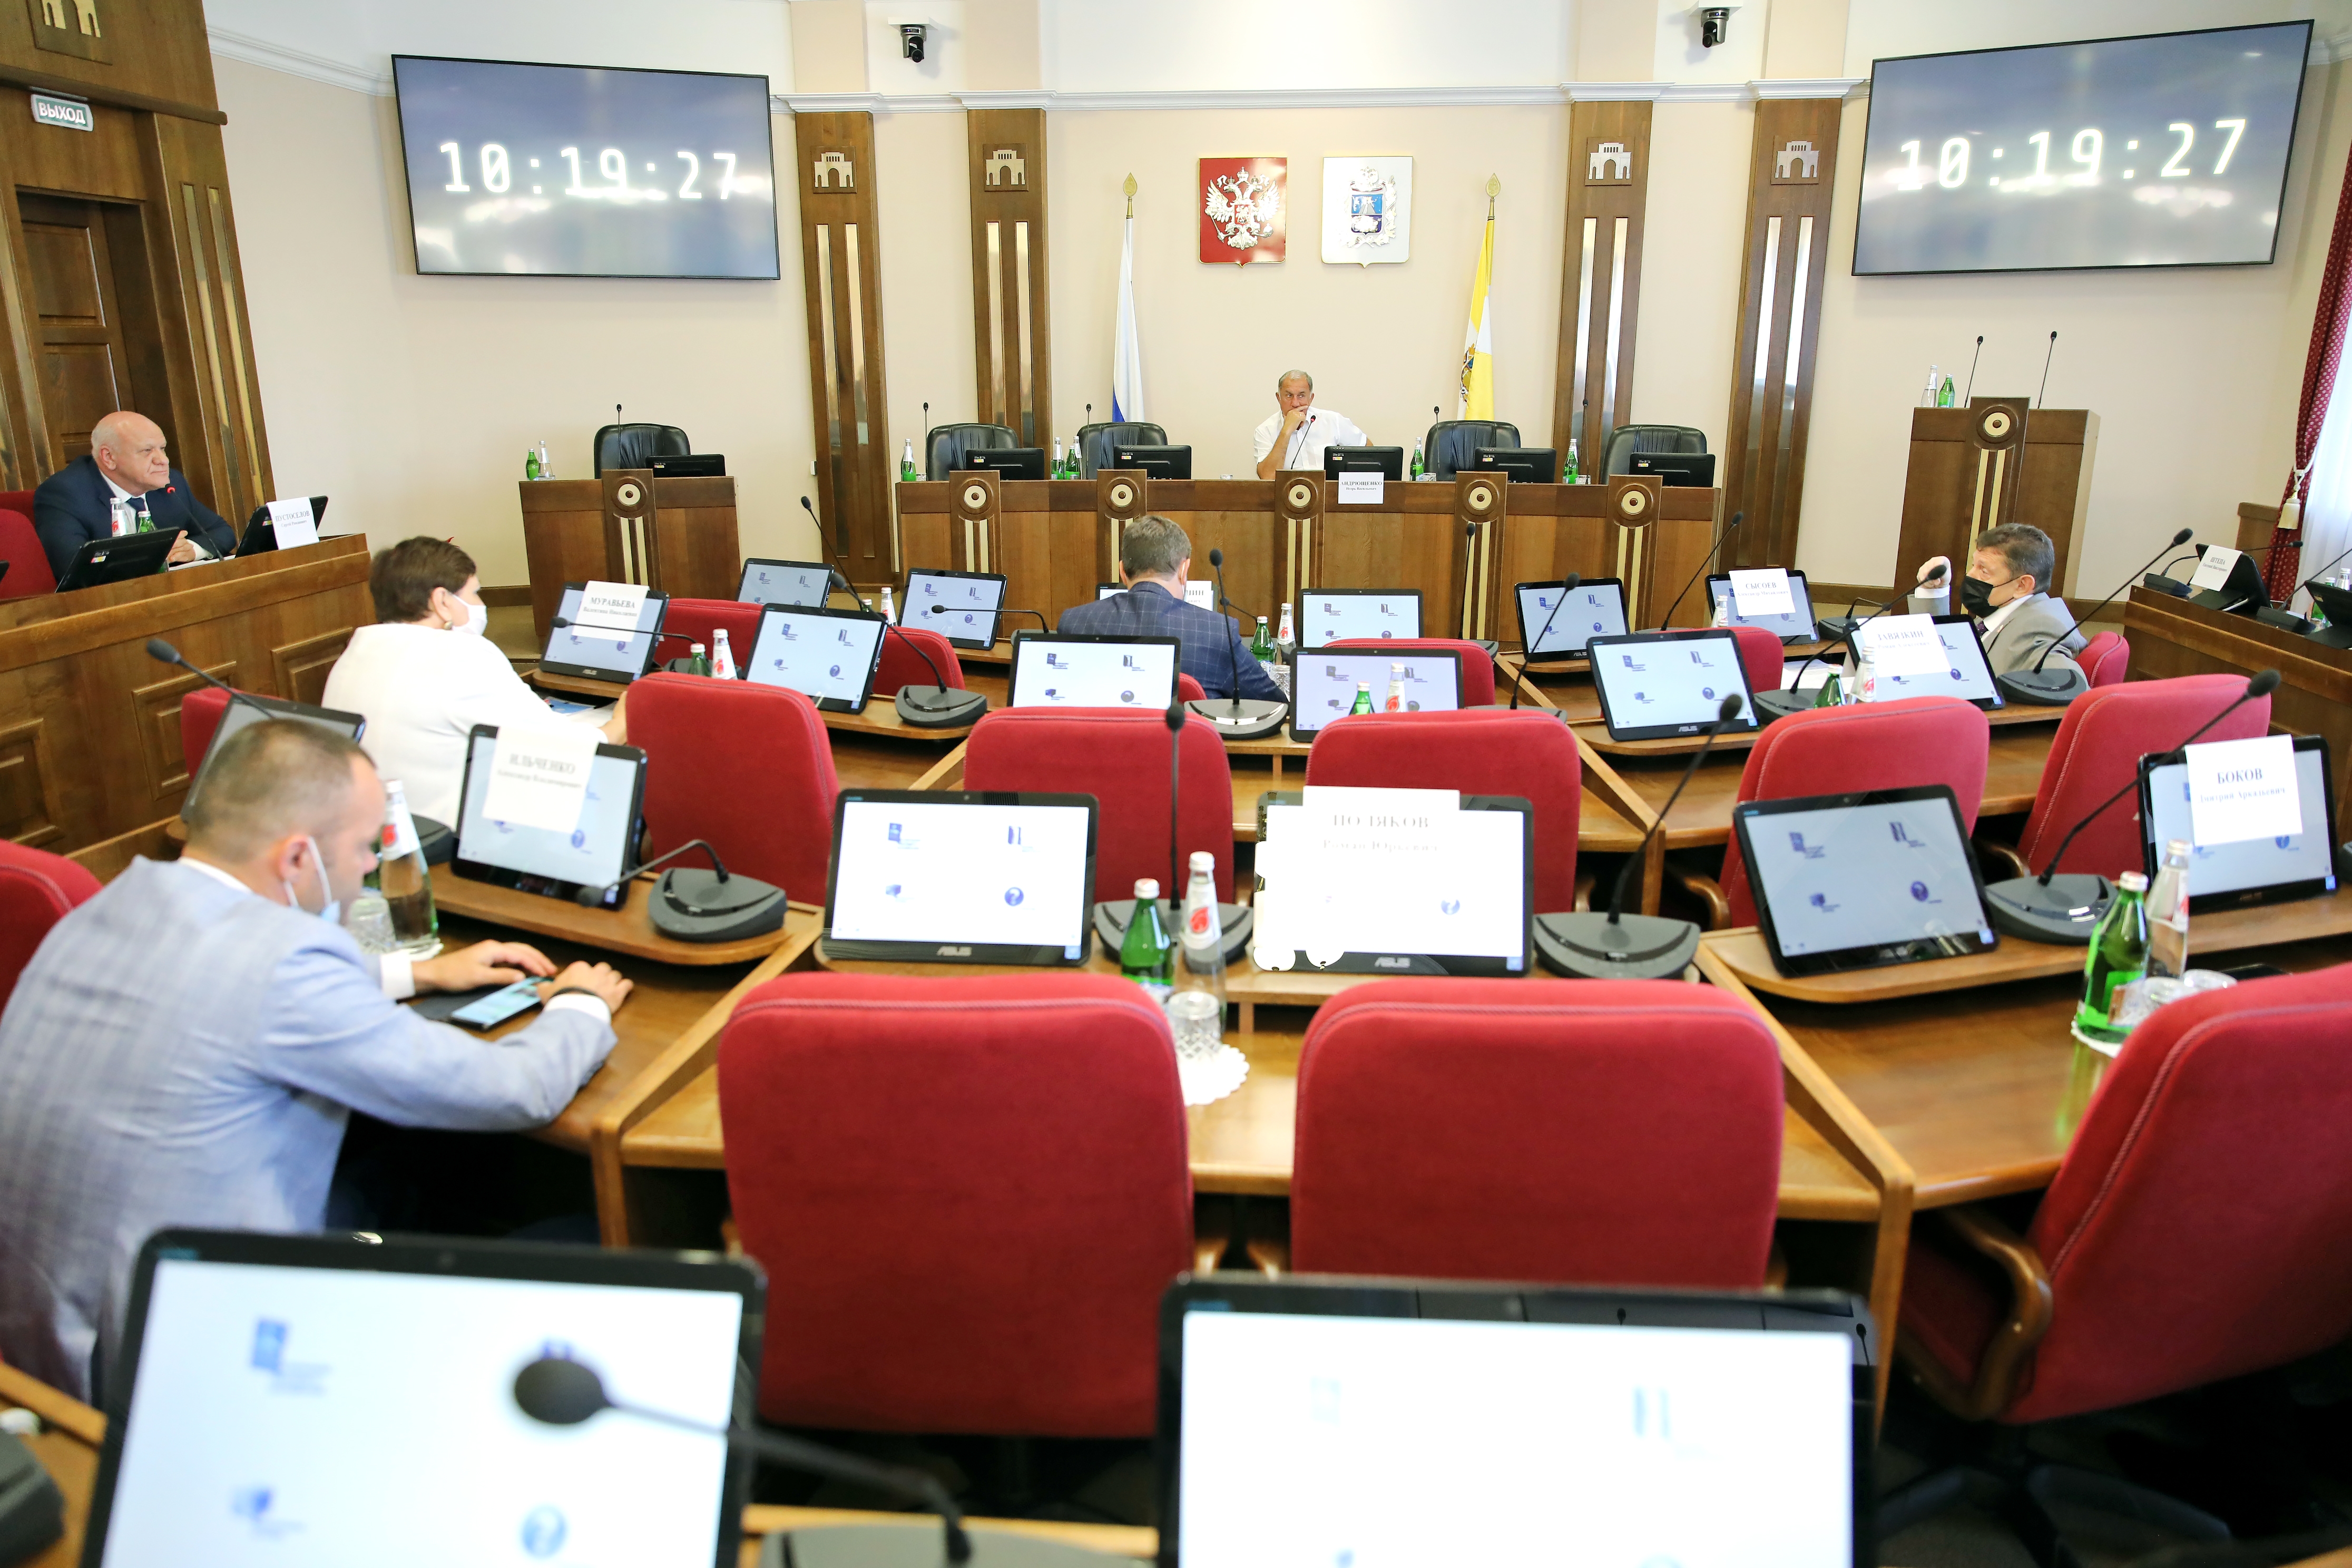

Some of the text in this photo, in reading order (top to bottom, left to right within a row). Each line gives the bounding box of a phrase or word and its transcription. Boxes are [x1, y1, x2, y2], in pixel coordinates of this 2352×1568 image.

[38, 102, 86, 124] ВЫХОД
[1896, 117, 2247, 191] 10:19:27
[439, 141, 738, 200] 10:19:27
[275, 510, 310, 522] ПУСТОСЕЛОВ
[591, 597, 635, 609] МУРАВЬЕВА
[1877, 630, 1924, 641] ЗАВЯЗКИН
[2217, 768, 2263, 785] БОКОВ
[936, 946, 973, 957] ASUS
[1374, 956, 1412, 968] ASUS
